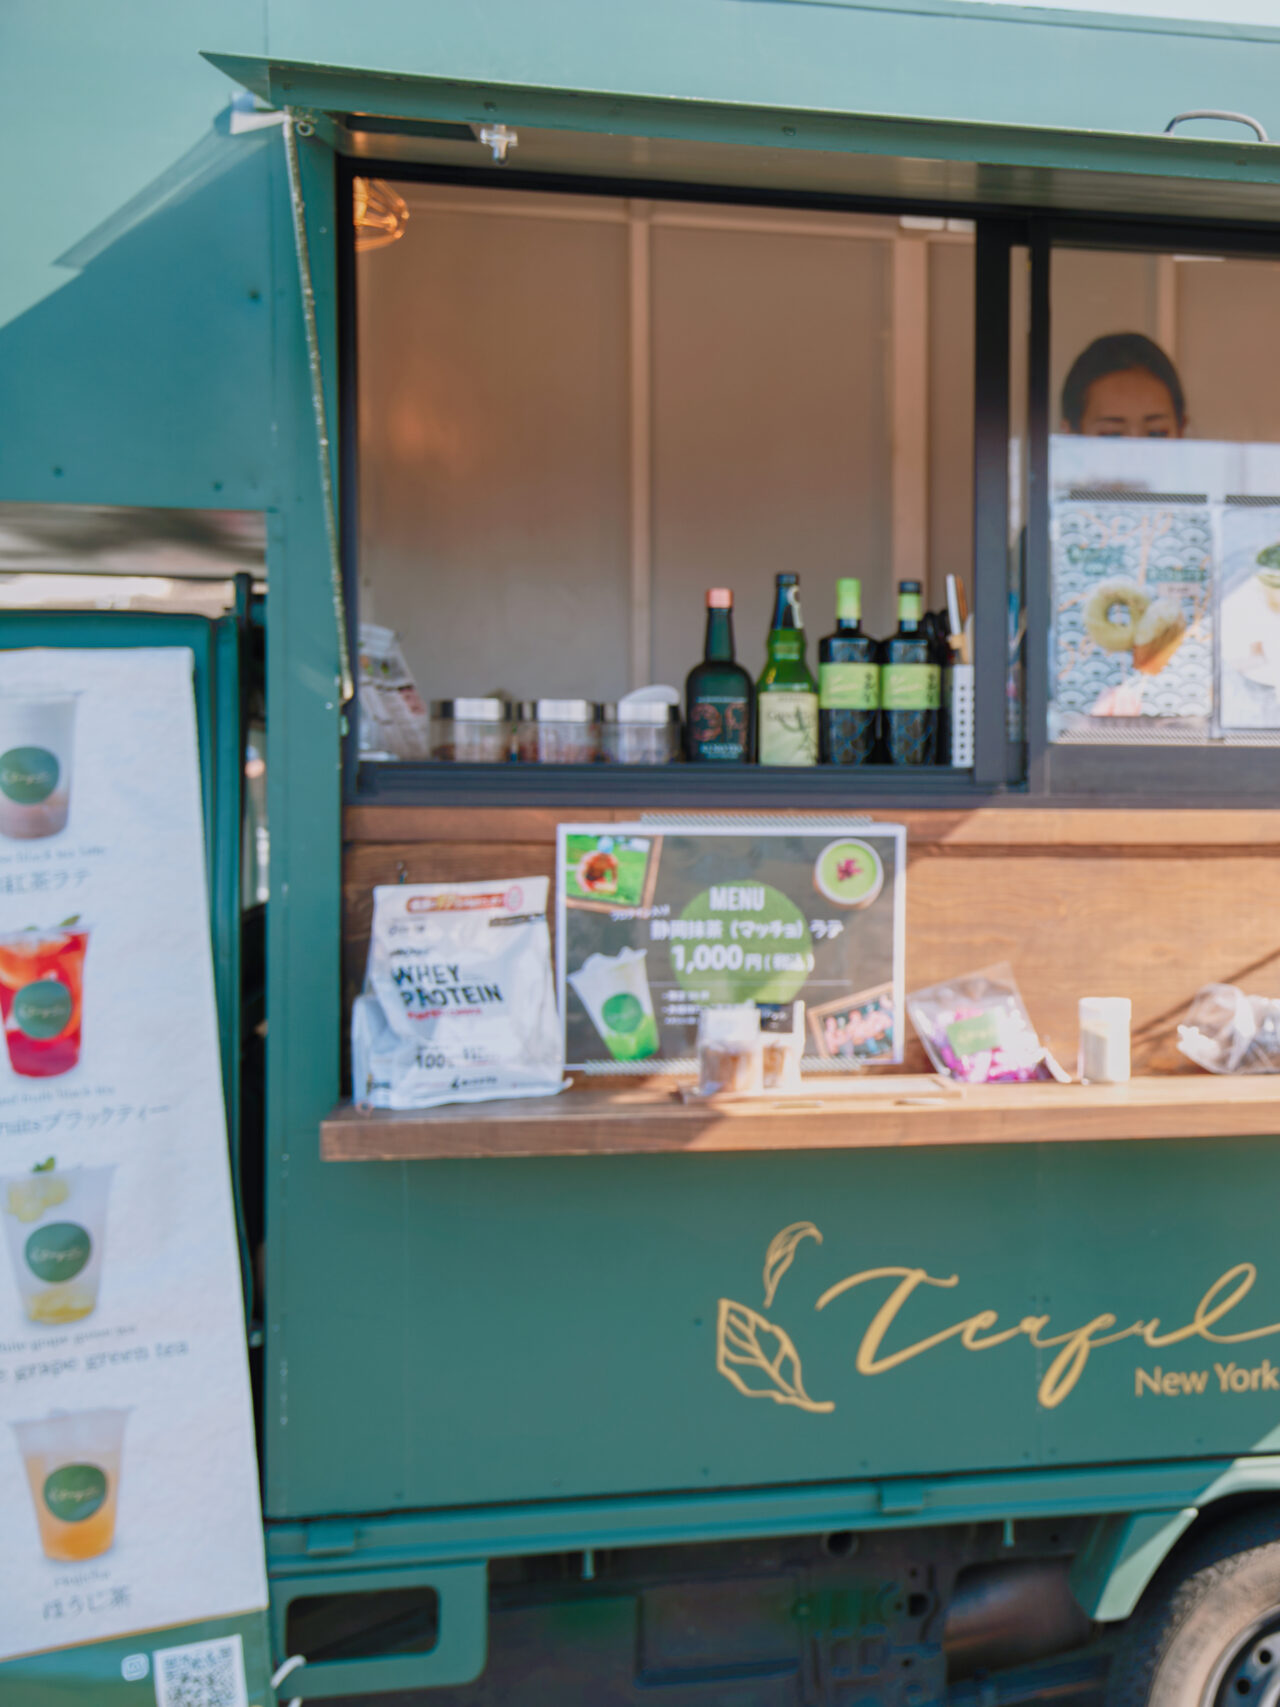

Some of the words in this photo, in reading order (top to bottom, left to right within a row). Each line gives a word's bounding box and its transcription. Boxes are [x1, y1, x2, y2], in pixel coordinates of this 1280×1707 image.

[0, 867, 93, 896] 紅茶ラテ
[709, 886, 765, 911] MENU
[392, 964, 460, 987] WHEY
[401, 983, 504, 1007] PROTEIN
[85, 1348, 149, 1372] green
[1135, 1366, 1209, 1396] New
[1214, 1360, 1280, 1393] York
[42, 1584, 131, 1619] ほうじ茶
